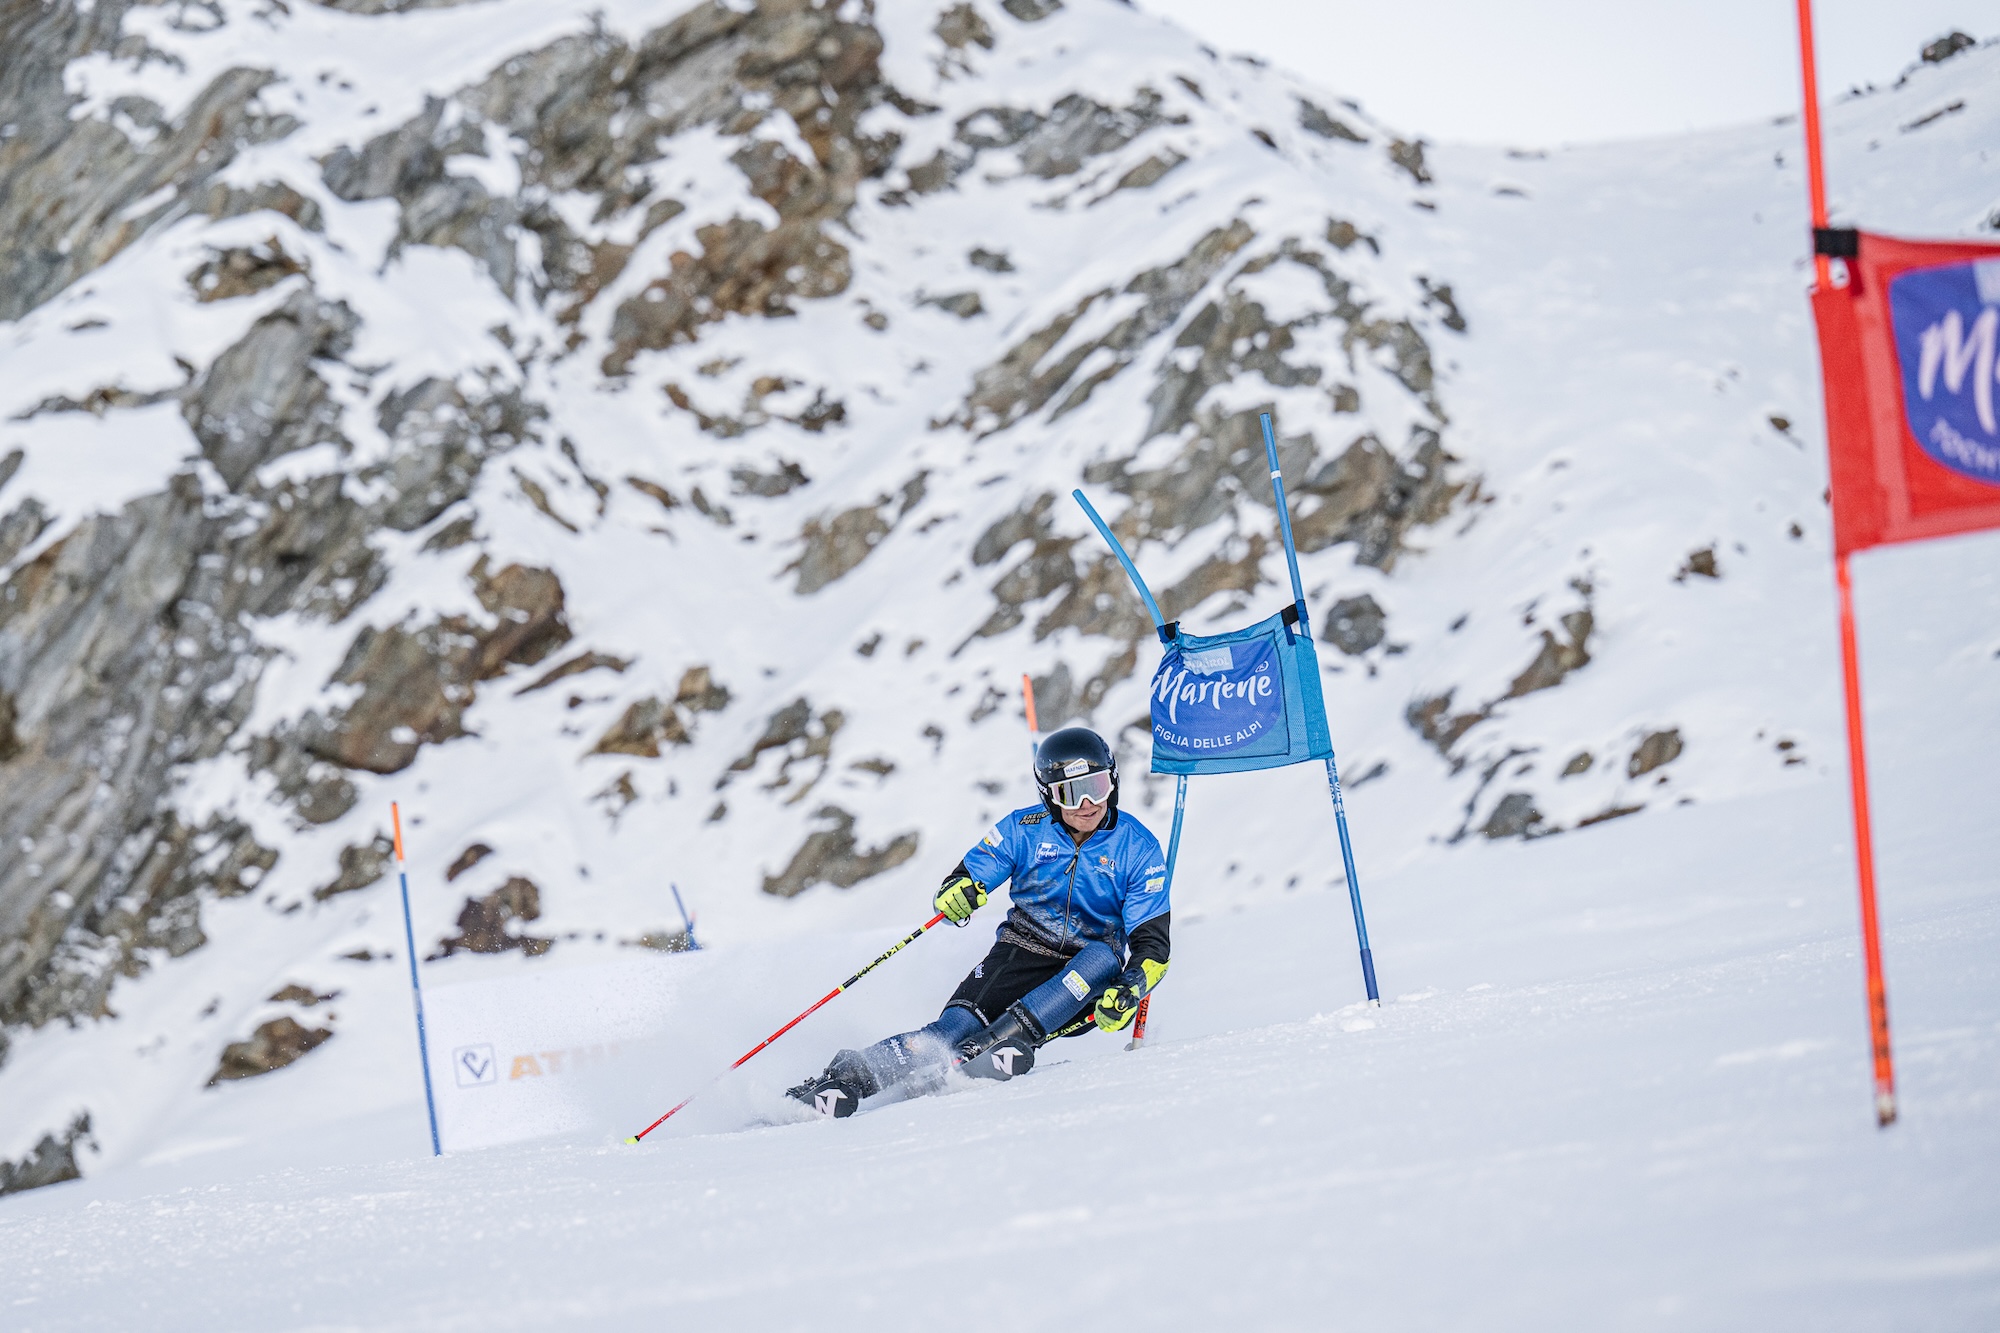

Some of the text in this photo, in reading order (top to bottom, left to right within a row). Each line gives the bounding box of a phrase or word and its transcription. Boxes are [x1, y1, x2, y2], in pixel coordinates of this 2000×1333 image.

[1150, 665, 1272, 725] Marlene
[1154, 720, 1263, 749] FIGLIA DELLE ALPI
[1065, 764, 1088, 774] HAFNER
[1013, 1006, 1041, 1039] NORDICA
